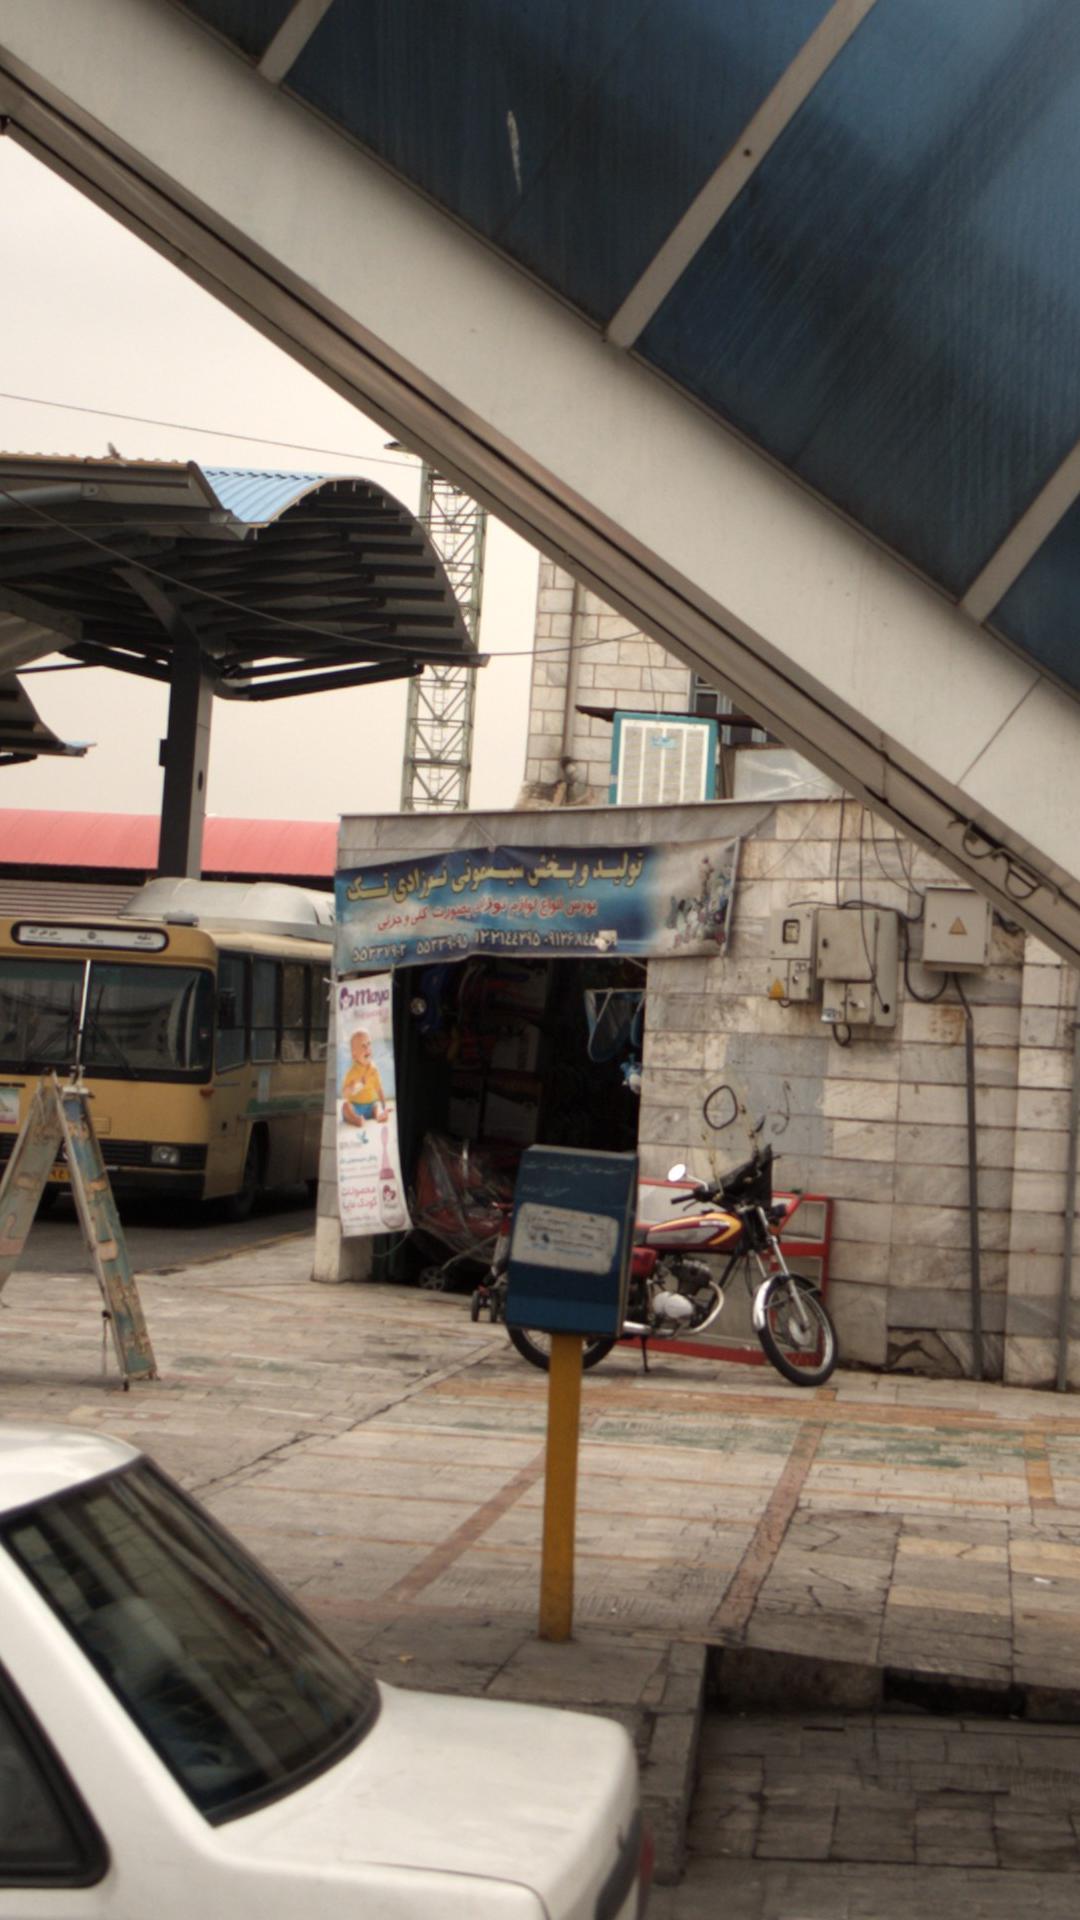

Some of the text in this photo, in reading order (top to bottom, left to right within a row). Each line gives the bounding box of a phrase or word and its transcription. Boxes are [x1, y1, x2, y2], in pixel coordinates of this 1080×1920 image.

[527, 853, 577, 889] پخش
[576, 863, 590, 888] و
[592, 852, 644, 887] تولید
